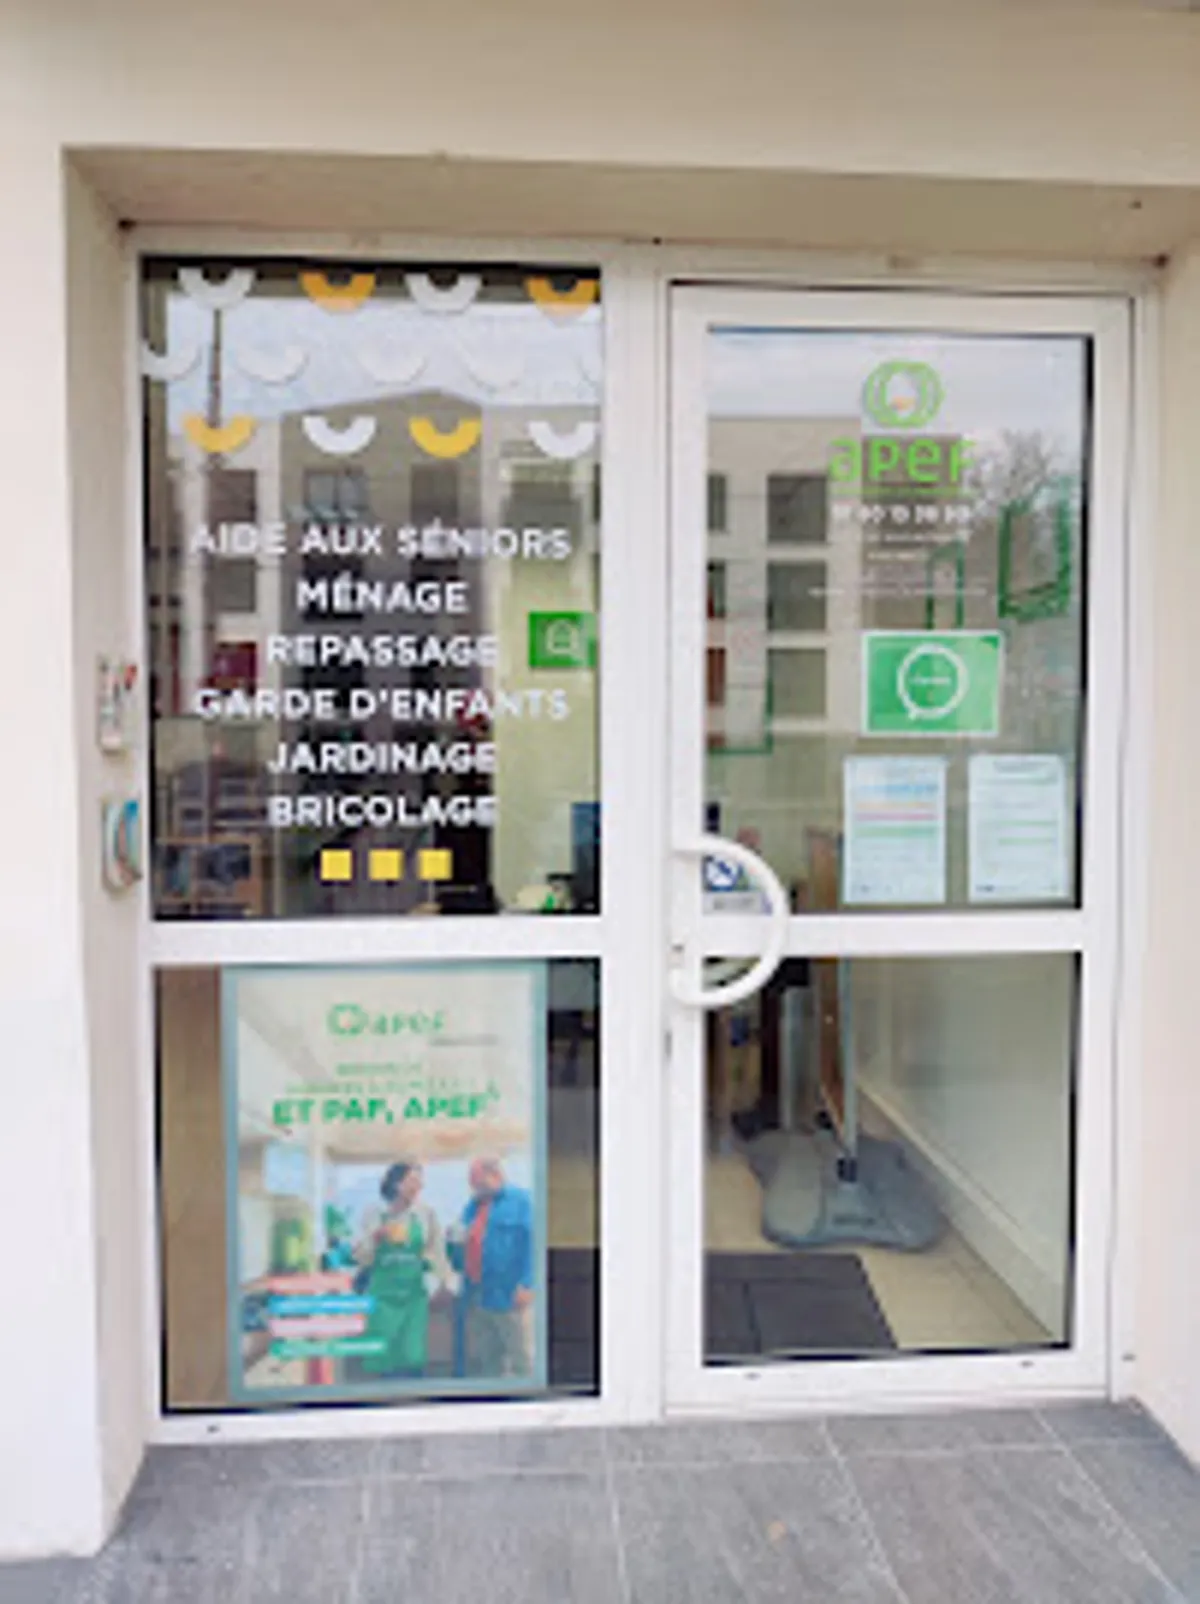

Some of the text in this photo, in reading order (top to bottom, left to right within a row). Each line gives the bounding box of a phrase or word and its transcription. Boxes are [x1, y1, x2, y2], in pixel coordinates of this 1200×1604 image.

[190, 517, 571, 560] AIDE AUX SÉNIORS
[295, 569, 468, 613] MÉNAGE
[266, 634, 498, 667] REPASSAGE
[194, 688, 570, 721] GARDE D'ENFANTS
[266, 742, 498, 774] JARDINAGE
[267, 796, 498, 827] BRICOLAGE
